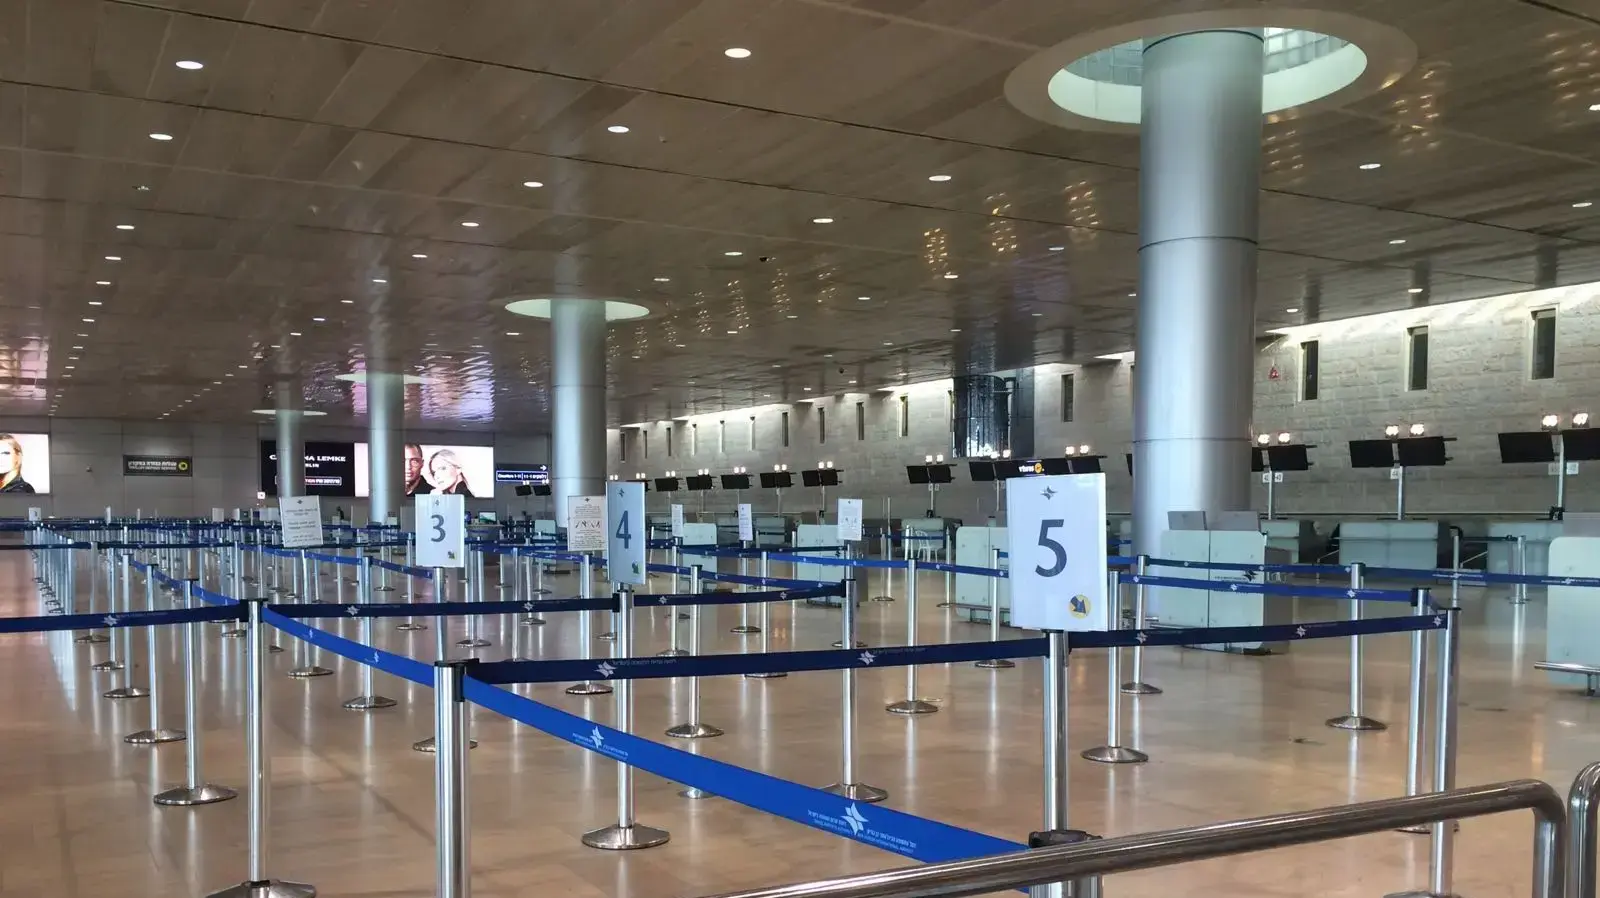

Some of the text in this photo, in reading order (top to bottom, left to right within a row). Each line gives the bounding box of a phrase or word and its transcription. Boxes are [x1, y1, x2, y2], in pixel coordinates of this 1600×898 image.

[431, 514, 446, 542] 3
[616, 510, 631, 549] 4
[1035, 519, 1067, 577] 5
